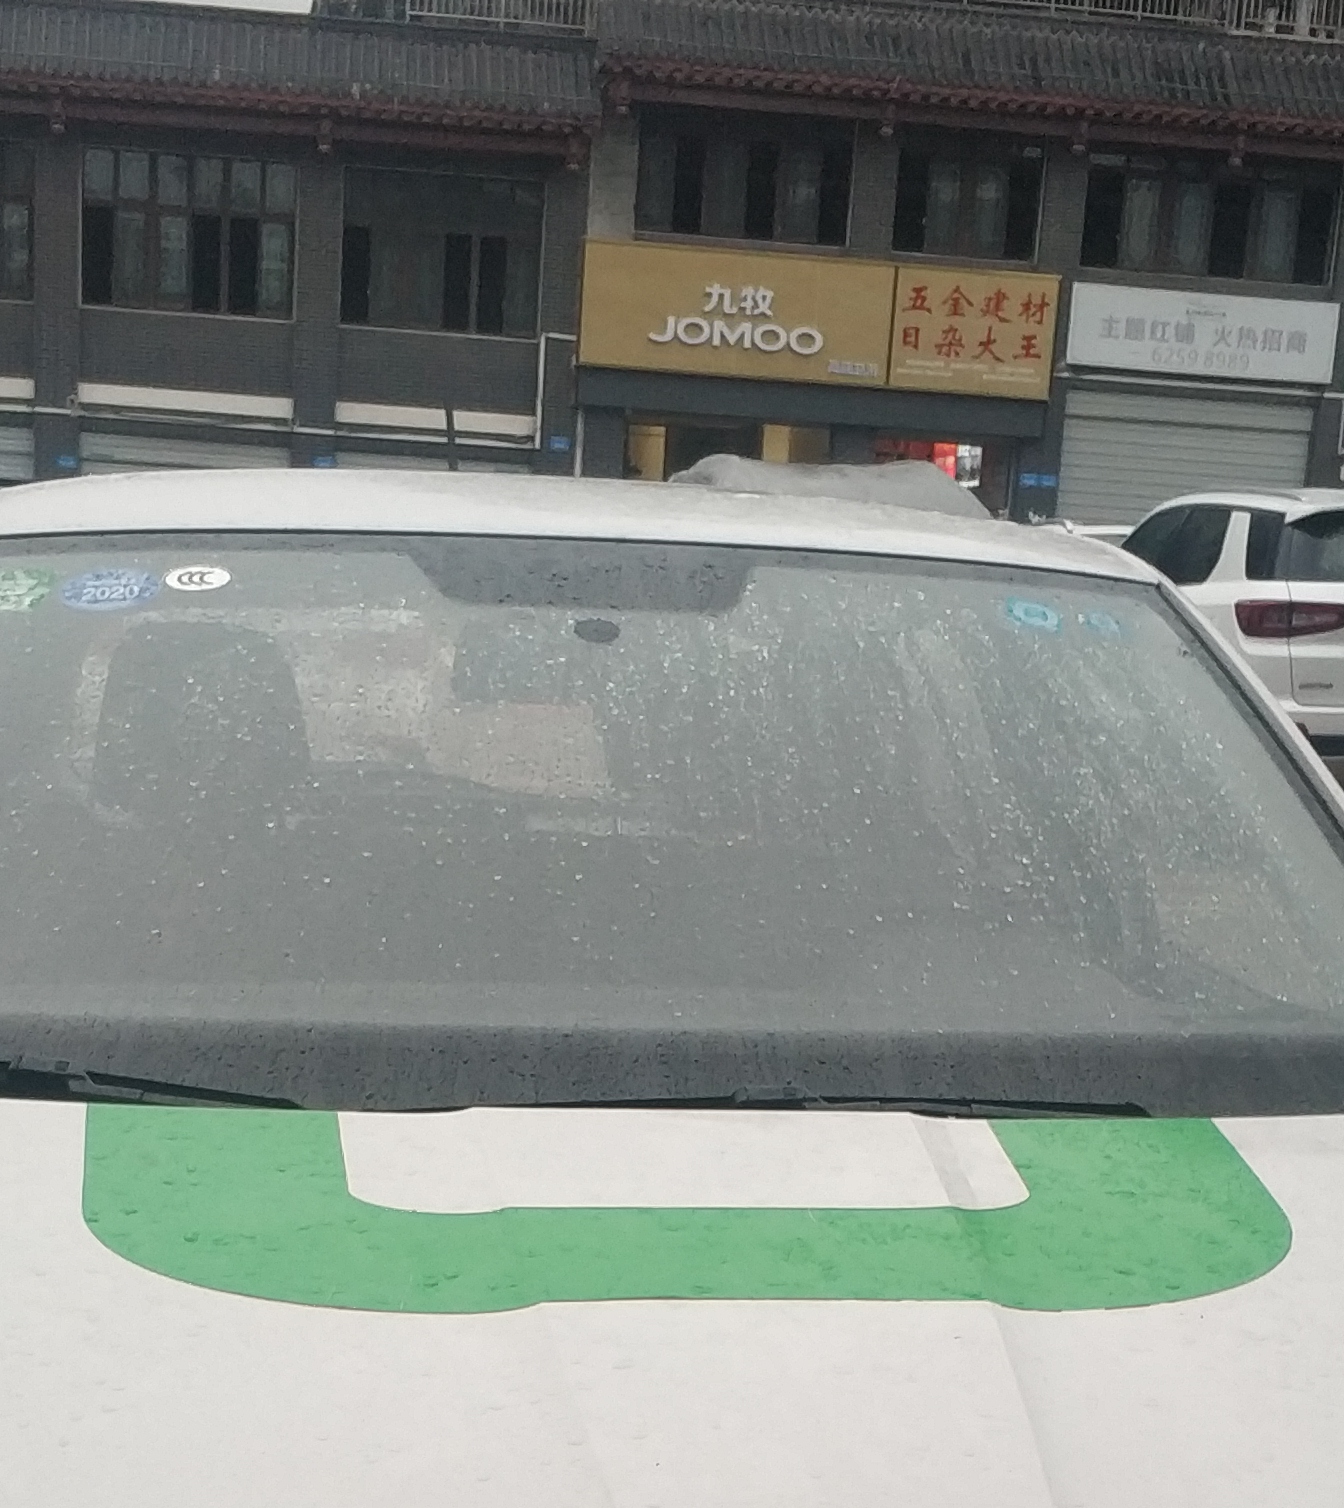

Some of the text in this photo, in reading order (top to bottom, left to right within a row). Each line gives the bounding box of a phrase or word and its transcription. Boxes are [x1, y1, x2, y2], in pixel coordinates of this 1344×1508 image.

[704, 283, 774, 317] 九牧
[902, 285, 1051, 325] 五金建材
[648, 315, 824, 355] JOMOO
[902, 325, 1042, 363] 日杂大王
[1213, 325, 1307, 353] 火热招商
[81, 585, 139, 601] 2020
